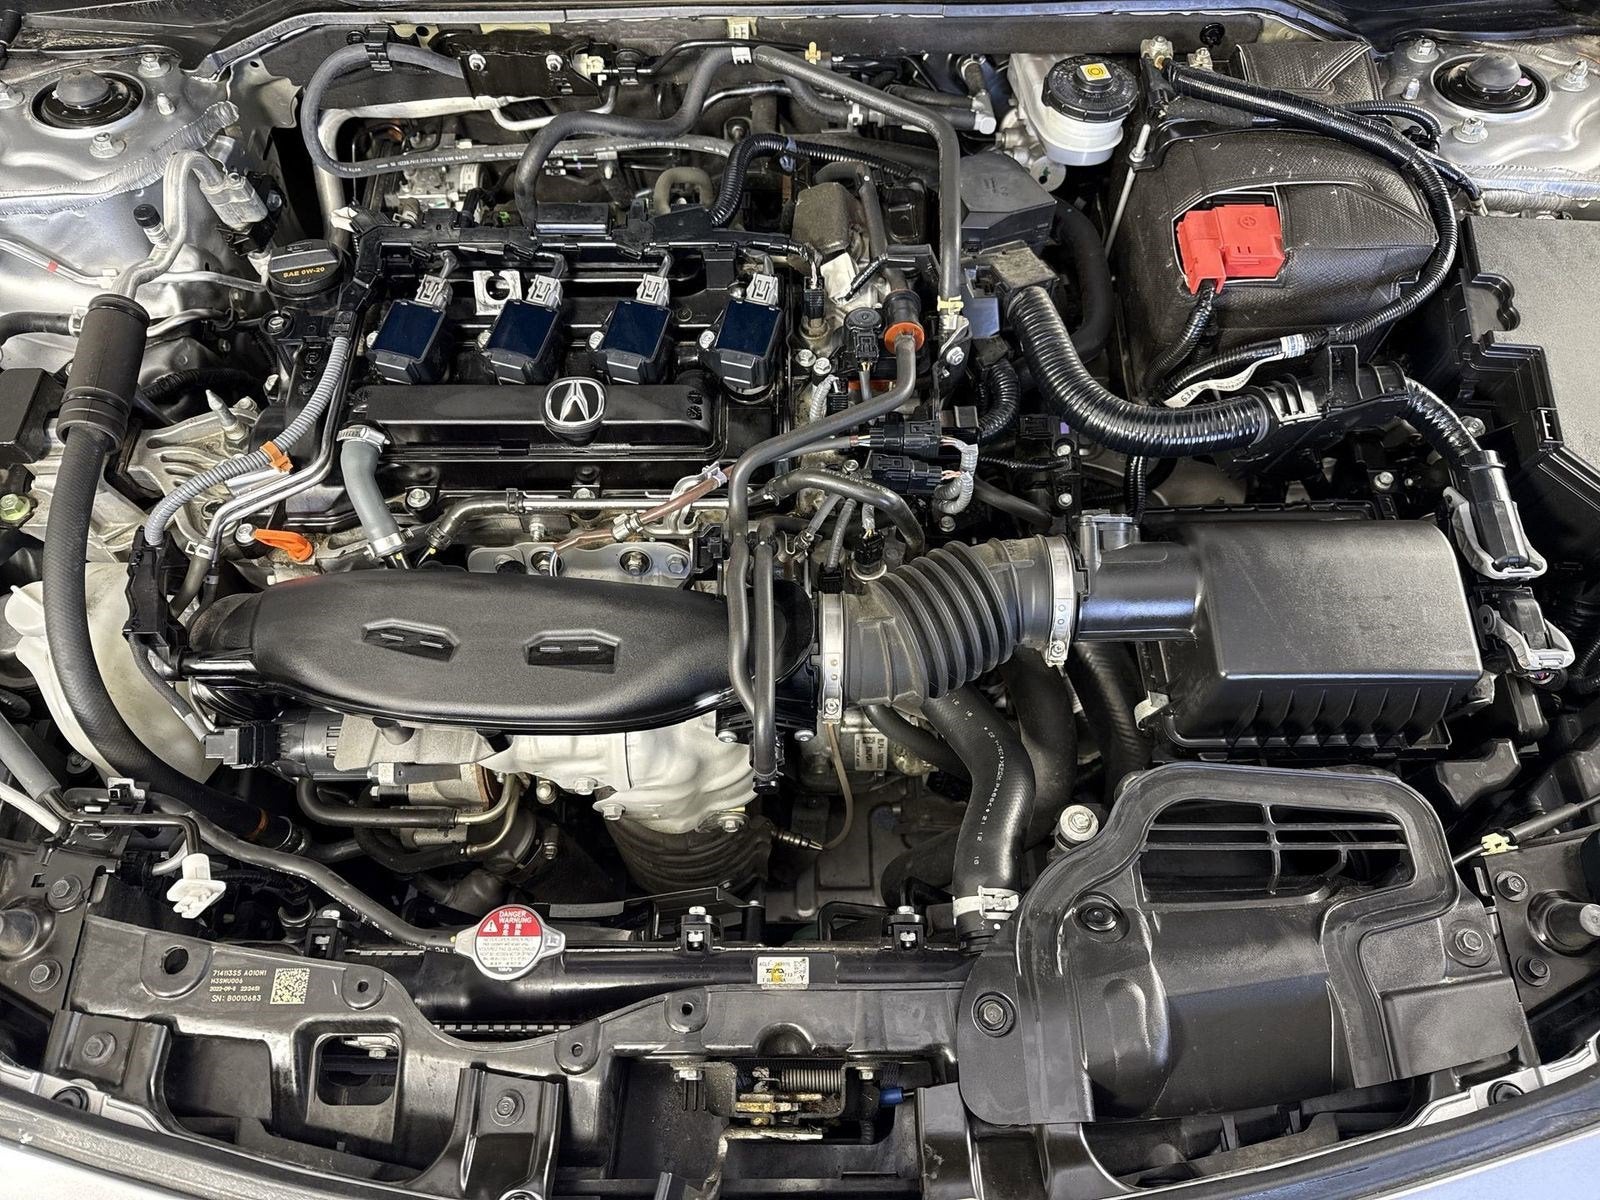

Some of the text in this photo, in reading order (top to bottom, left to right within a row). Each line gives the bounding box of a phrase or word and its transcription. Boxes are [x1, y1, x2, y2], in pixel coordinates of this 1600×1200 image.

[283, 266, 325, 278] SAE 0W-20
[1181, 389, 1196, 402] 63A
[499, 910, 527, 918] DANGER
